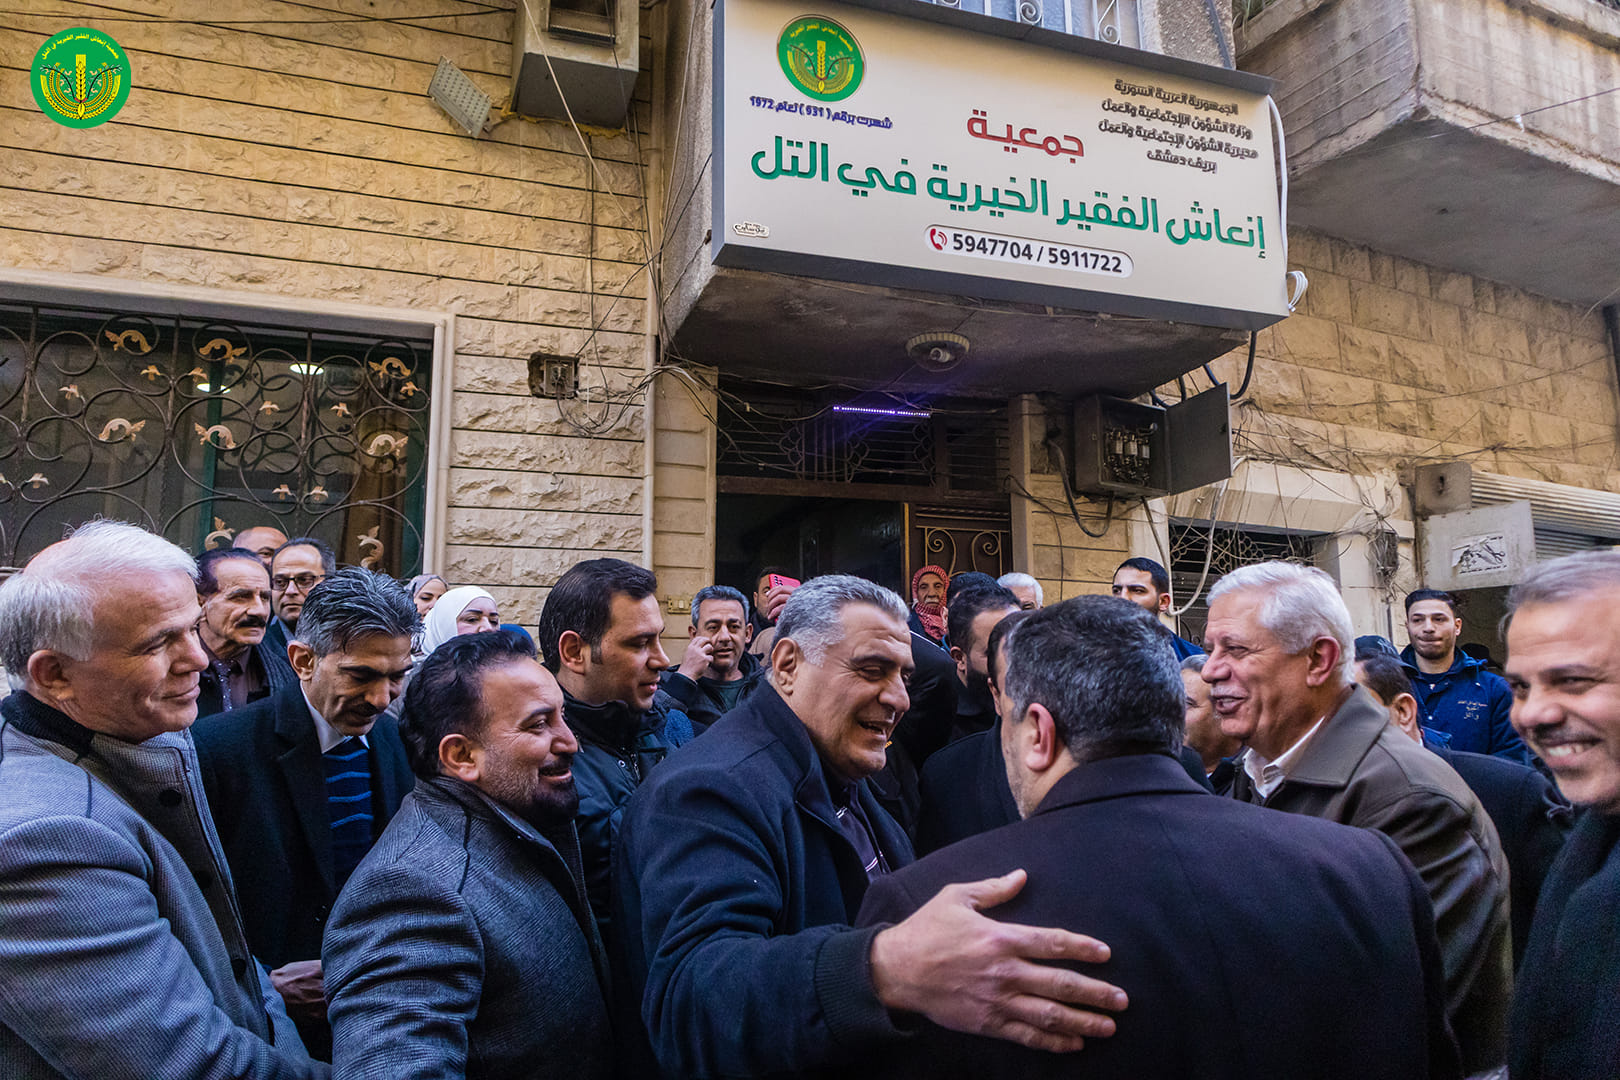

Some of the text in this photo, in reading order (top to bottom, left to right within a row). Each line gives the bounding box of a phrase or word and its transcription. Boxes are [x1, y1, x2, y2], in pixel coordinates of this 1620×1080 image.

[750, 95, 774, 109] 1972
[775, 101, 799, 112] لعام
[1115, 79, 1239, 116] الجمهورية العربية السورية
[1102, 98, 1138, 118] والعمل
[832, 111, 856, 125] برقم
[1192, 116, 1229, 134] الشؤون
[967, 109, 1085, 163] جمعية
[1098, 118, 1134, 138] والعمل
[1229, 123, 1254, 140] وزارة
[1186, 136, 1224, 153] الشؤون
[1224, 145, 1259, 160] مديرية
[1146, 149, 1217, 174] بريف دمشق
[751, 135, 1266, 259] إنعاش الفقير الخيرية في التل
[952, 233, 1033, 261] 5947704
[1048, 248, 1123, 273] 5911722
